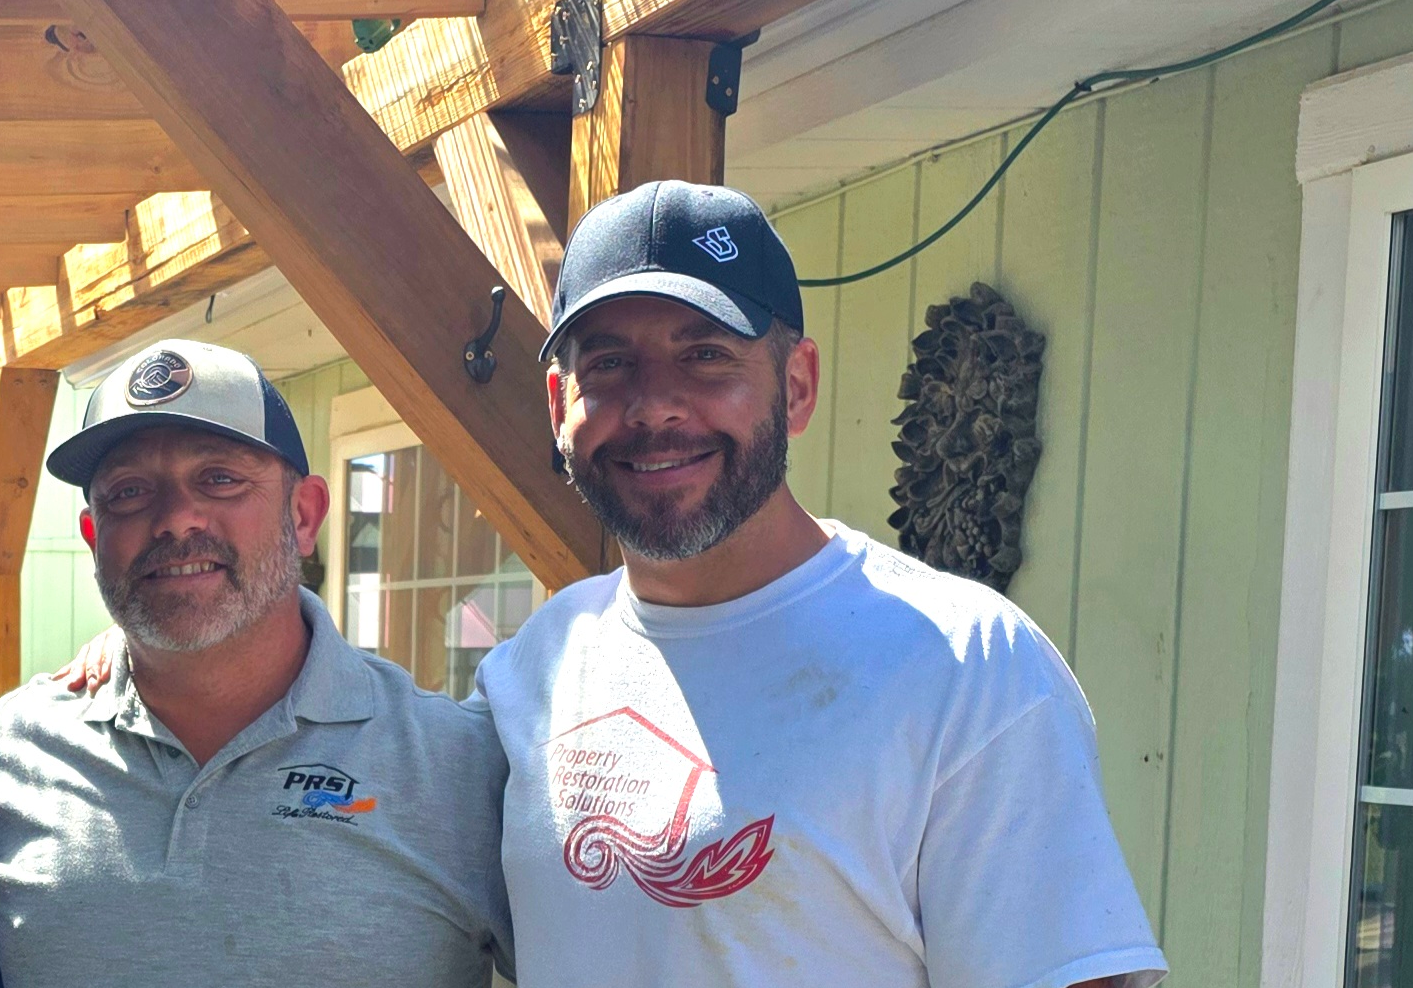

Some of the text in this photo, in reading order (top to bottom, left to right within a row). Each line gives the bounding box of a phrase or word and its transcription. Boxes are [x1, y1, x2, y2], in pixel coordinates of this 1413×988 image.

[136, 354, 182, 374] COLORADO
[550, 743, 623, 774] Property
[552, 765, 650, 795] Restoration
[555, 788, 635, 817] Solutions
